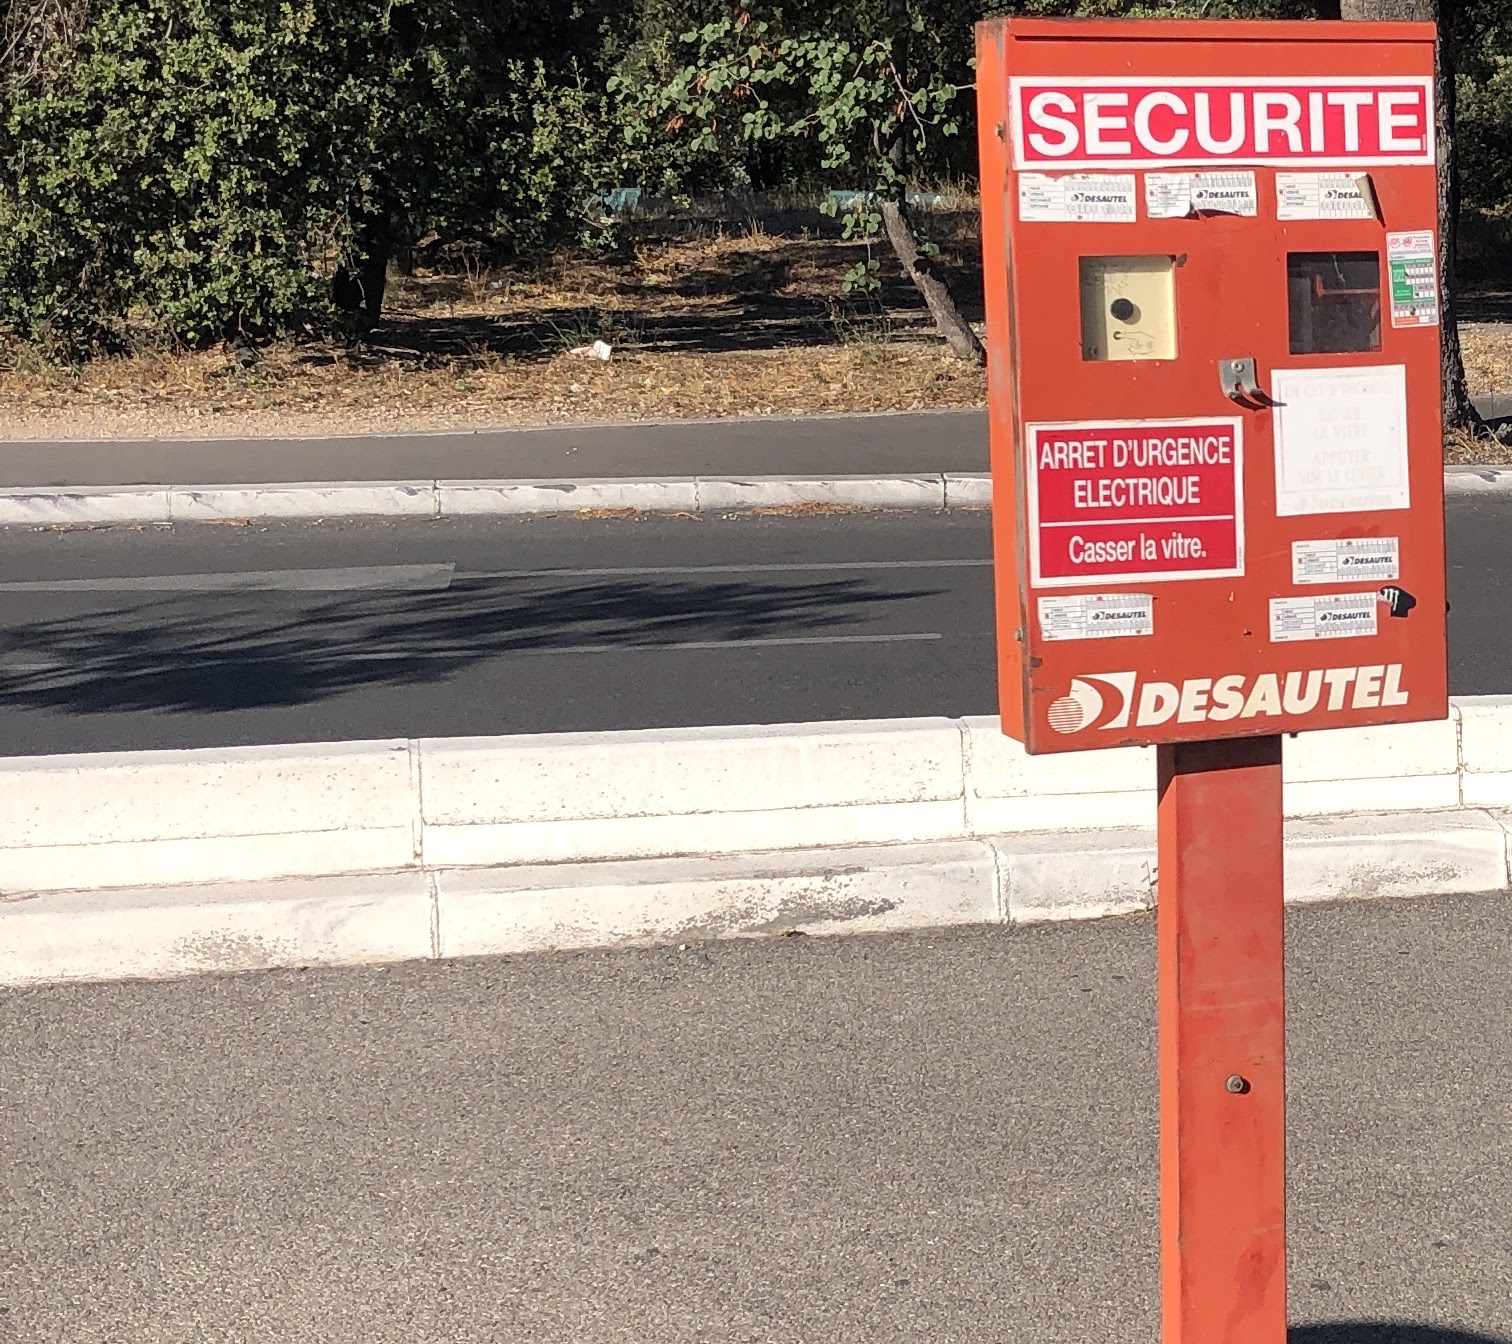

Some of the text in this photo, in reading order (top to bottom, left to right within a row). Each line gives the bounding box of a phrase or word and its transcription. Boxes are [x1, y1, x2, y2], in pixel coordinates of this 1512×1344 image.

[1028, 91, 1422, 157] SECURITE
[1084, 195, 1127, 203] DESAUTEL
[1208, 190, 1250, 199] DESAUTEL
[1039, 436, 1231, 470] ARRET D'URGENCE
[1073, 476, 1201, 508] ELECTRIQUE
[1068, 535, 1136, 564] Casser
[1140, 532, 1158, 561] la
[1161, 532, 1208, 561] vitre.
[1354, 556, 1393, 565] DESAUTEL
[1104, 610, 1147, 620] DESAUTEL
[1332, 611, 1371, 621] DESAUTEL
[1135, 663, 1409, 727] DESAUTEL
